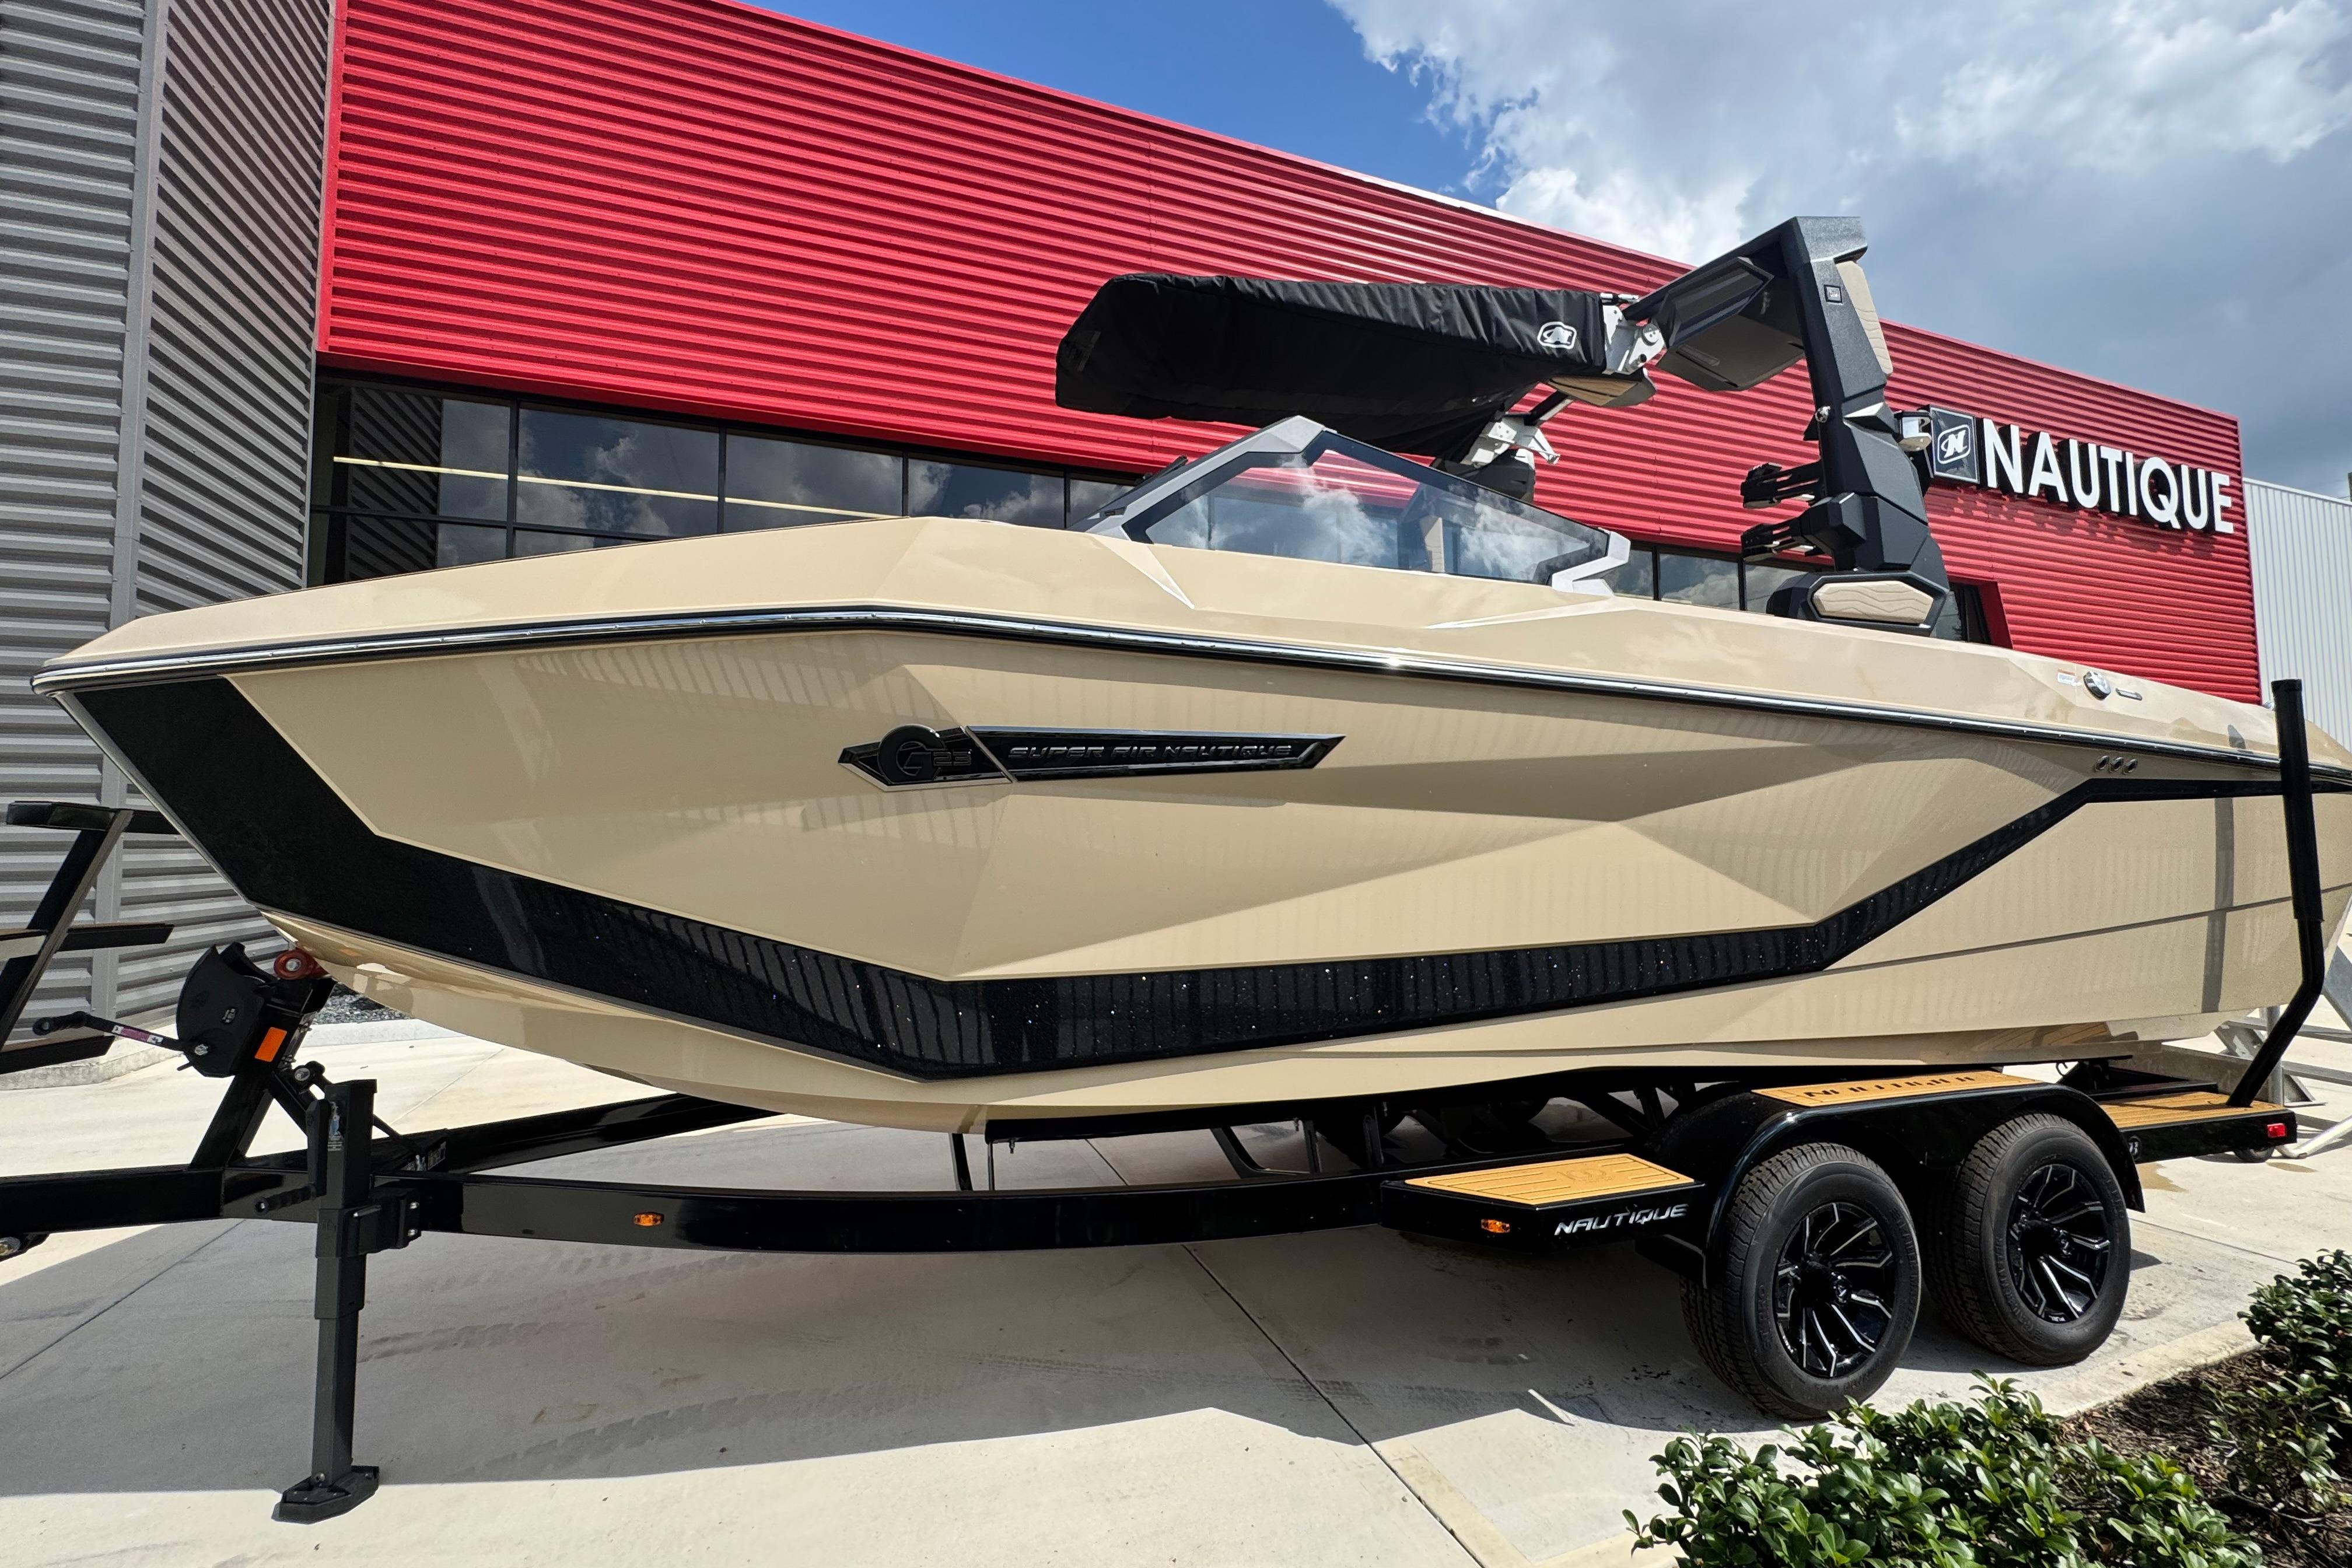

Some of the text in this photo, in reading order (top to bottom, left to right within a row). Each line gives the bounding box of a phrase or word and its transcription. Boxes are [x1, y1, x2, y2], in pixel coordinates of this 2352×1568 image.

[1982, 418, 2234, 533] NAUTIQUE
[1009, 745, 1293, 758] SUPER AIR NAUTIQUE
[1554, 1204, 1689, 1236] NAUTIQUE
